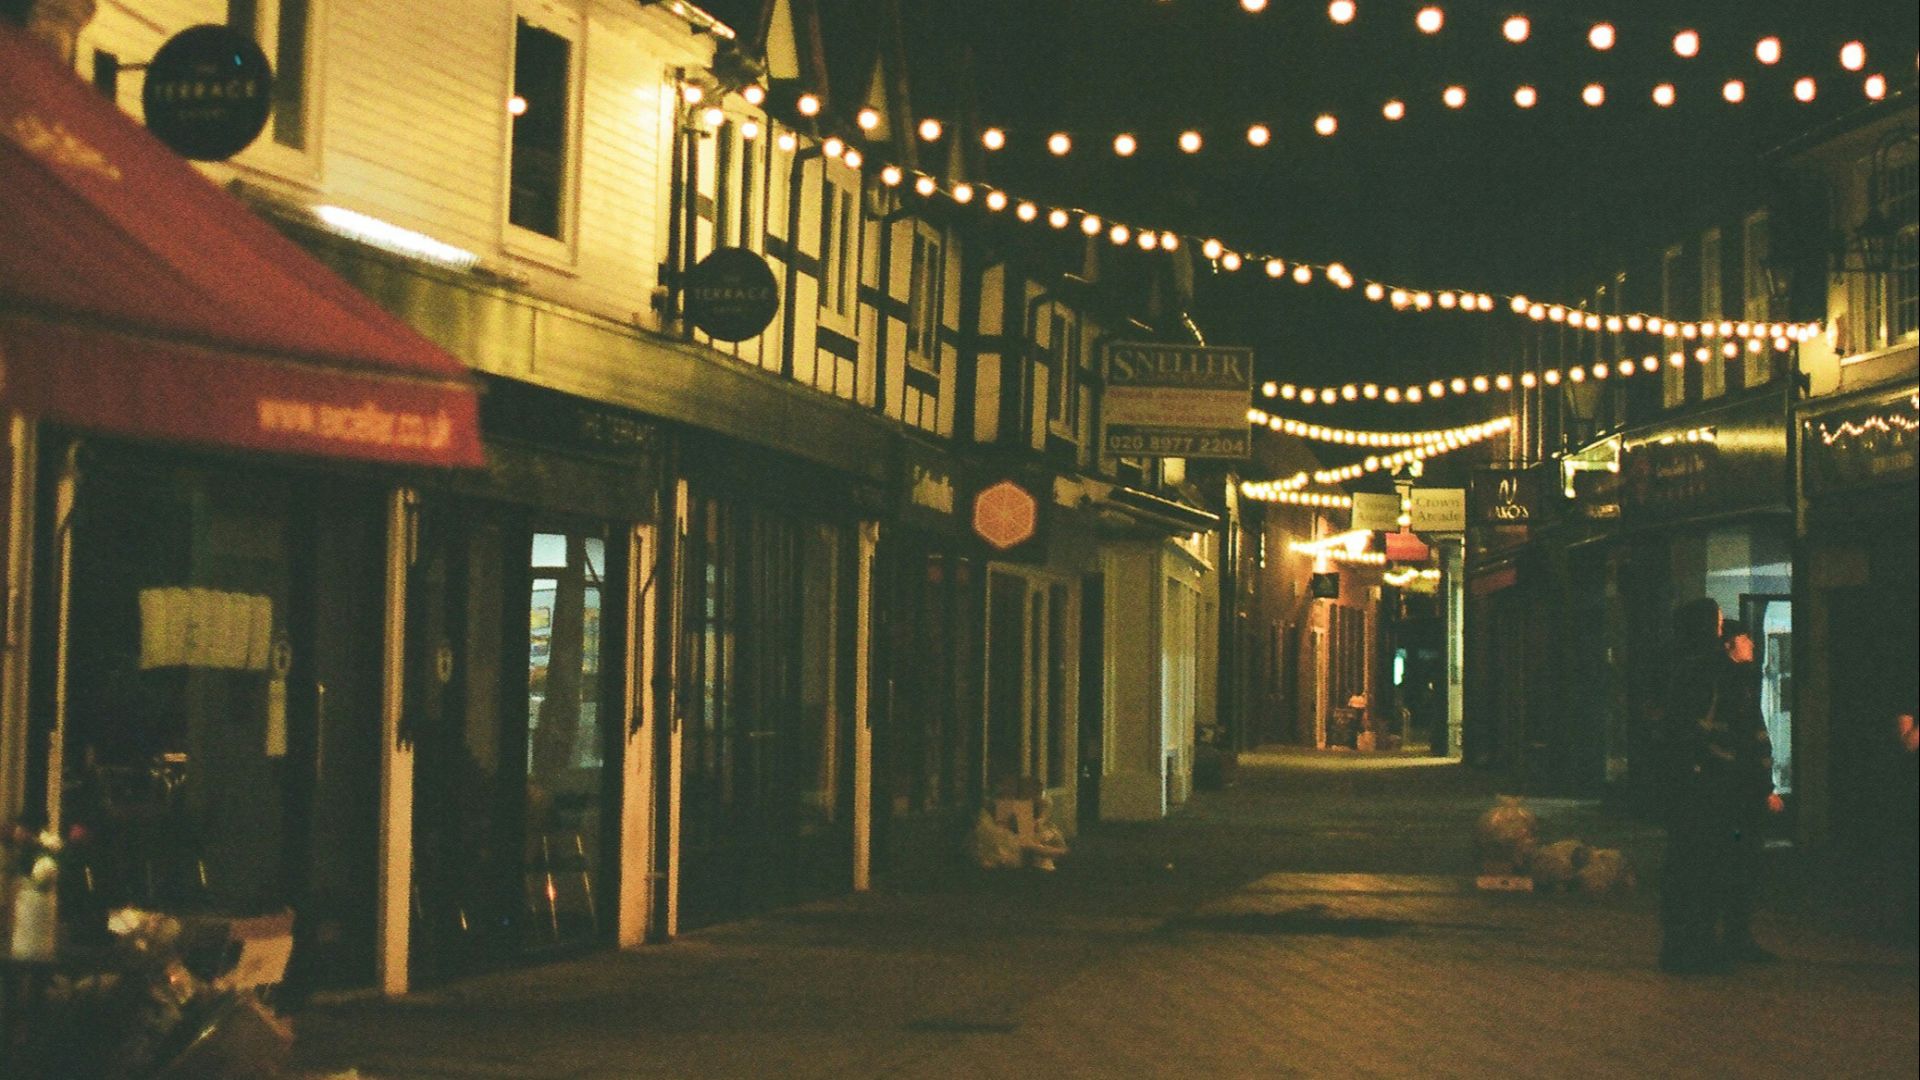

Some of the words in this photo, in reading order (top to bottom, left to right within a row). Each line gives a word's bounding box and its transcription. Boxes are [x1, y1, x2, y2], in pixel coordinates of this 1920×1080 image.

[155, 81, 256, 101] TERRACE
[1114, 350, 1245, 382] SNELLER
[1110, 435, 1143, 450] 020
[1149, 436, 1193, 451] 8977
[1200, 437, 1245, 453] 2204
[1415, 498, 1461, 508] Crown
[1418, 511, 1459, 522] Arcade
